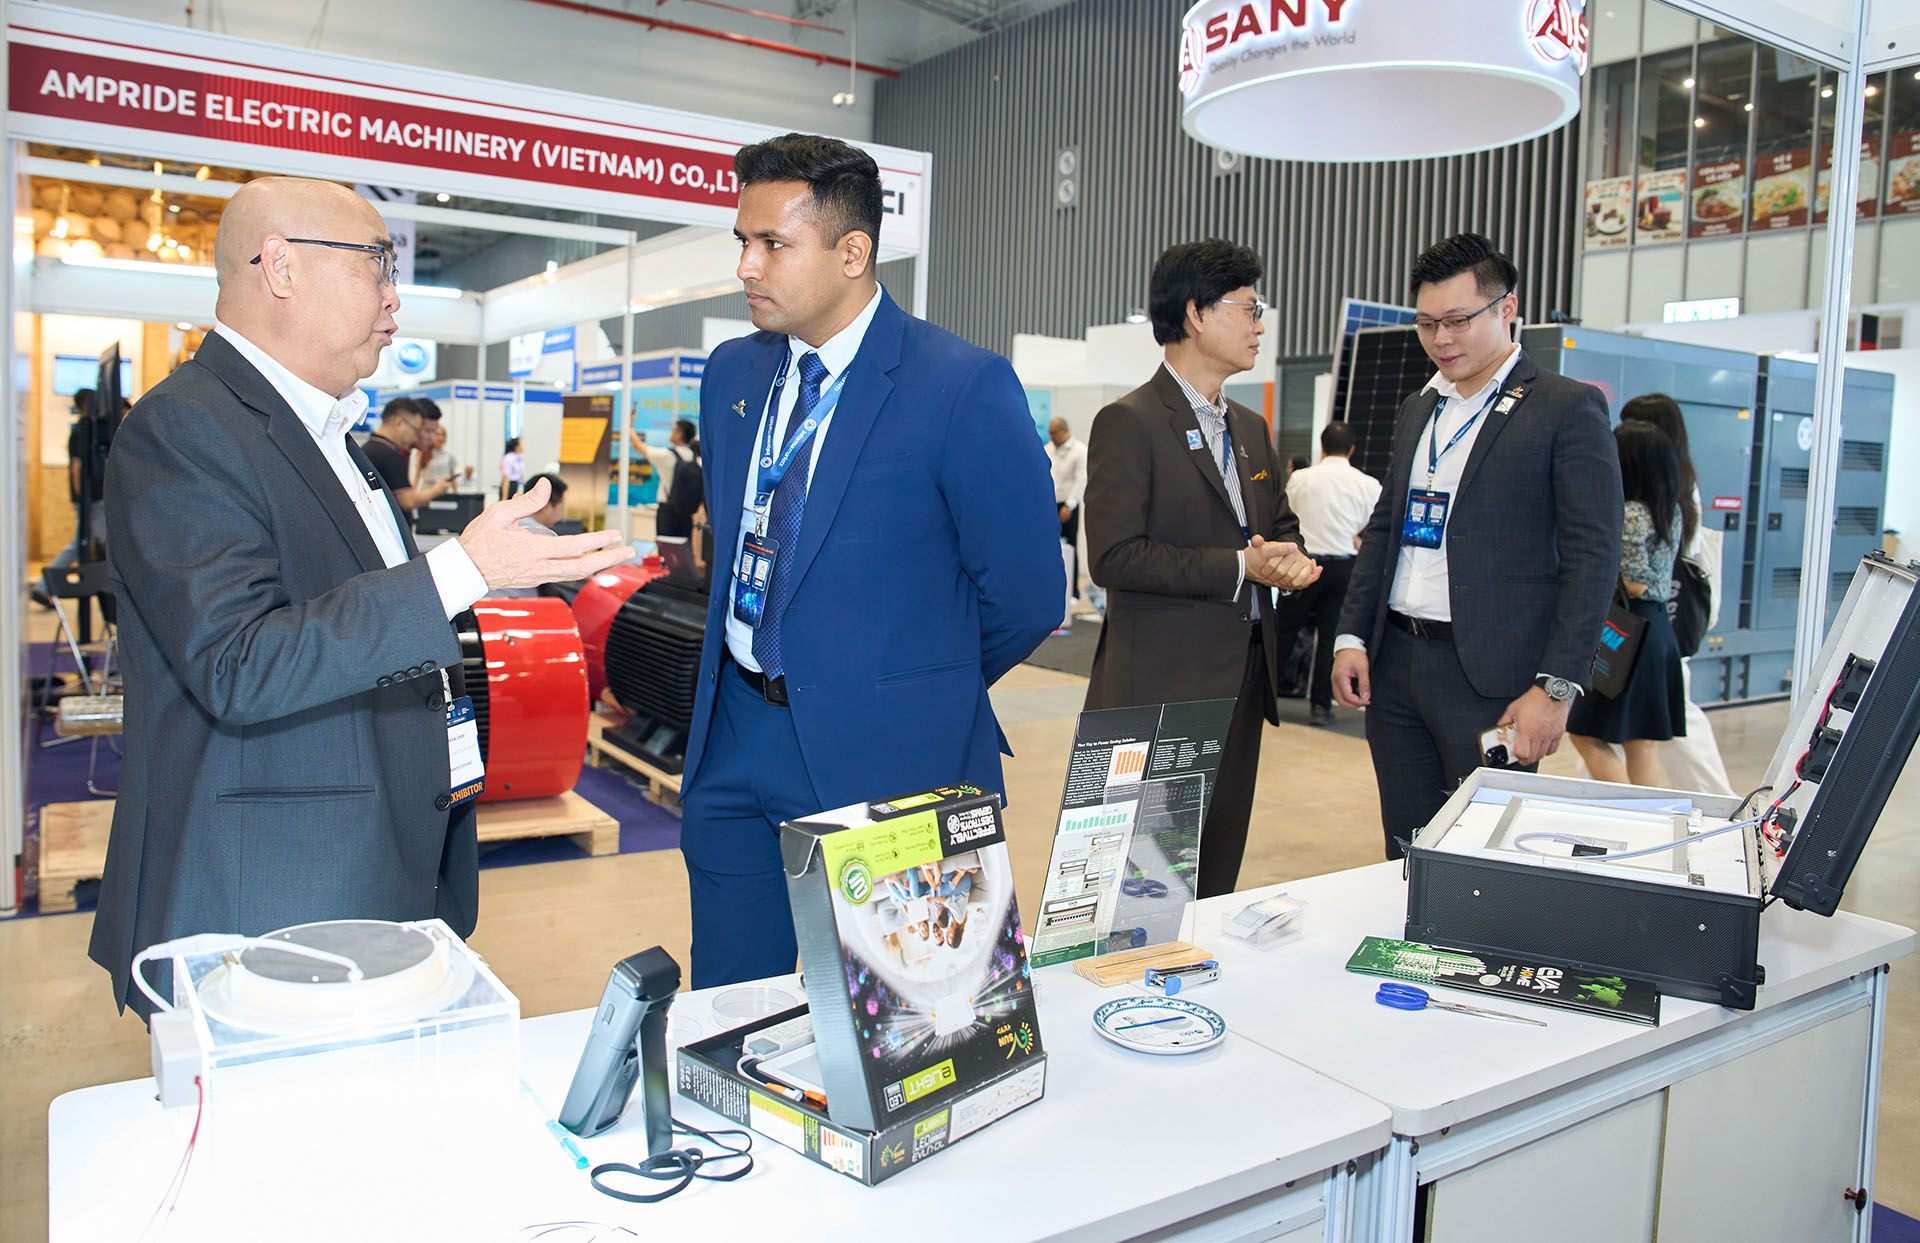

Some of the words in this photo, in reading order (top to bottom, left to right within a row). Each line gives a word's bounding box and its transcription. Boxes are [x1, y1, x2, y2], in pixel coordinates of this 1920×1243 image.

[1206, 0, 1348, 53] SANY
[1208, 56, 1237, 75] Quality
[1240, 42, 1288, 63] Changes
[1291, 38, 1310, 50] the
[1314, 31, 1357, 46] World
[39, 68, 197, 117] AMPRIDE
[205, 93, 353, 138] ELECTRIC
[359, 115, 527, 163] MACHINERY
[531, 140, 665, 185] (VIETNAM)
[959, 813, 995, 832] DESTROYS
[949, 823, 997, 846] EFFECTIVELY
[997, 1032, 1014, 1047] SUN
[889, 1094, 904, 1108] LED
